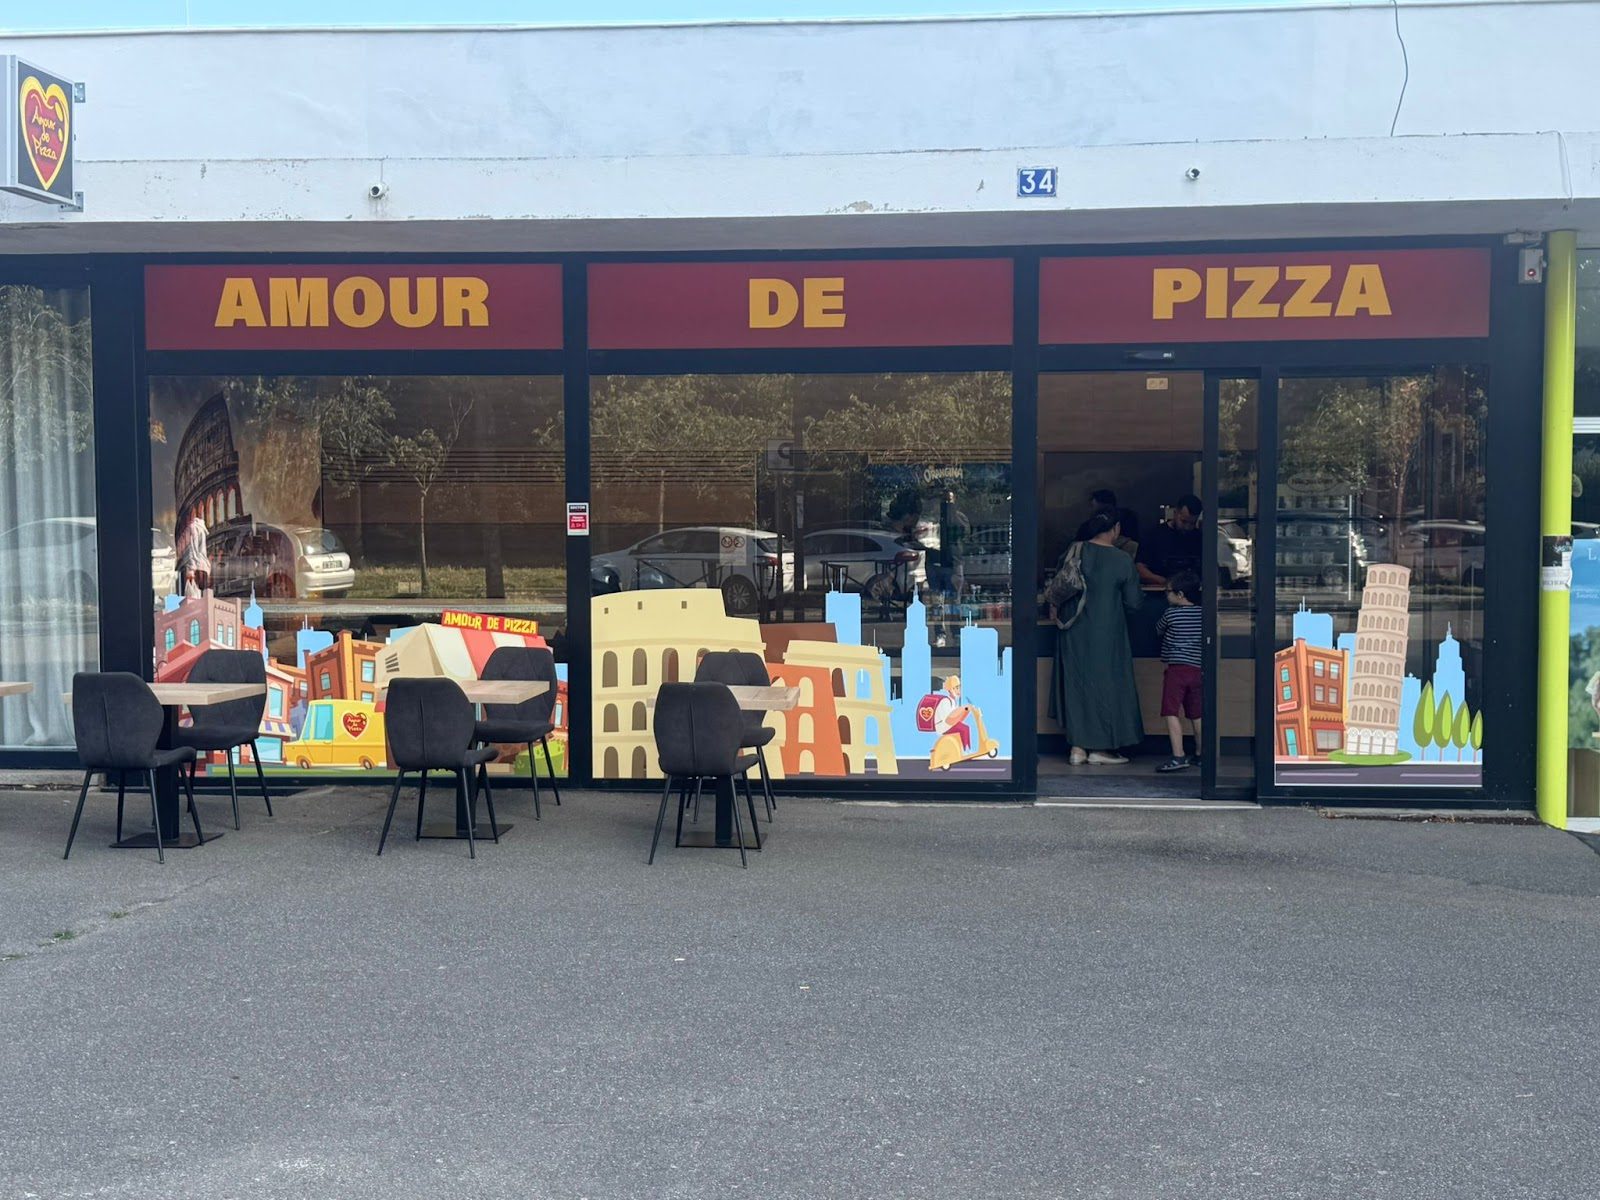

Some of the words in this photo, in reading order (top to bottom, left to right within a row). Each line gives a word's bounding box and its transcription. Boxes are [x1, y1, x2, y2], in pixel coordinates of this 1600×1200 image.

[1021, 170, 1053, 193] 34
[215, 277, 489, 328] AMOUR
[749, 278, 846, 329] DE
[1152, 265, 1393, 320] PIZZA
[444, 611, 482, 630] AMOUR
[486, 616, 500, 630] DE
[504, 618, 537, 634] PIZZA
